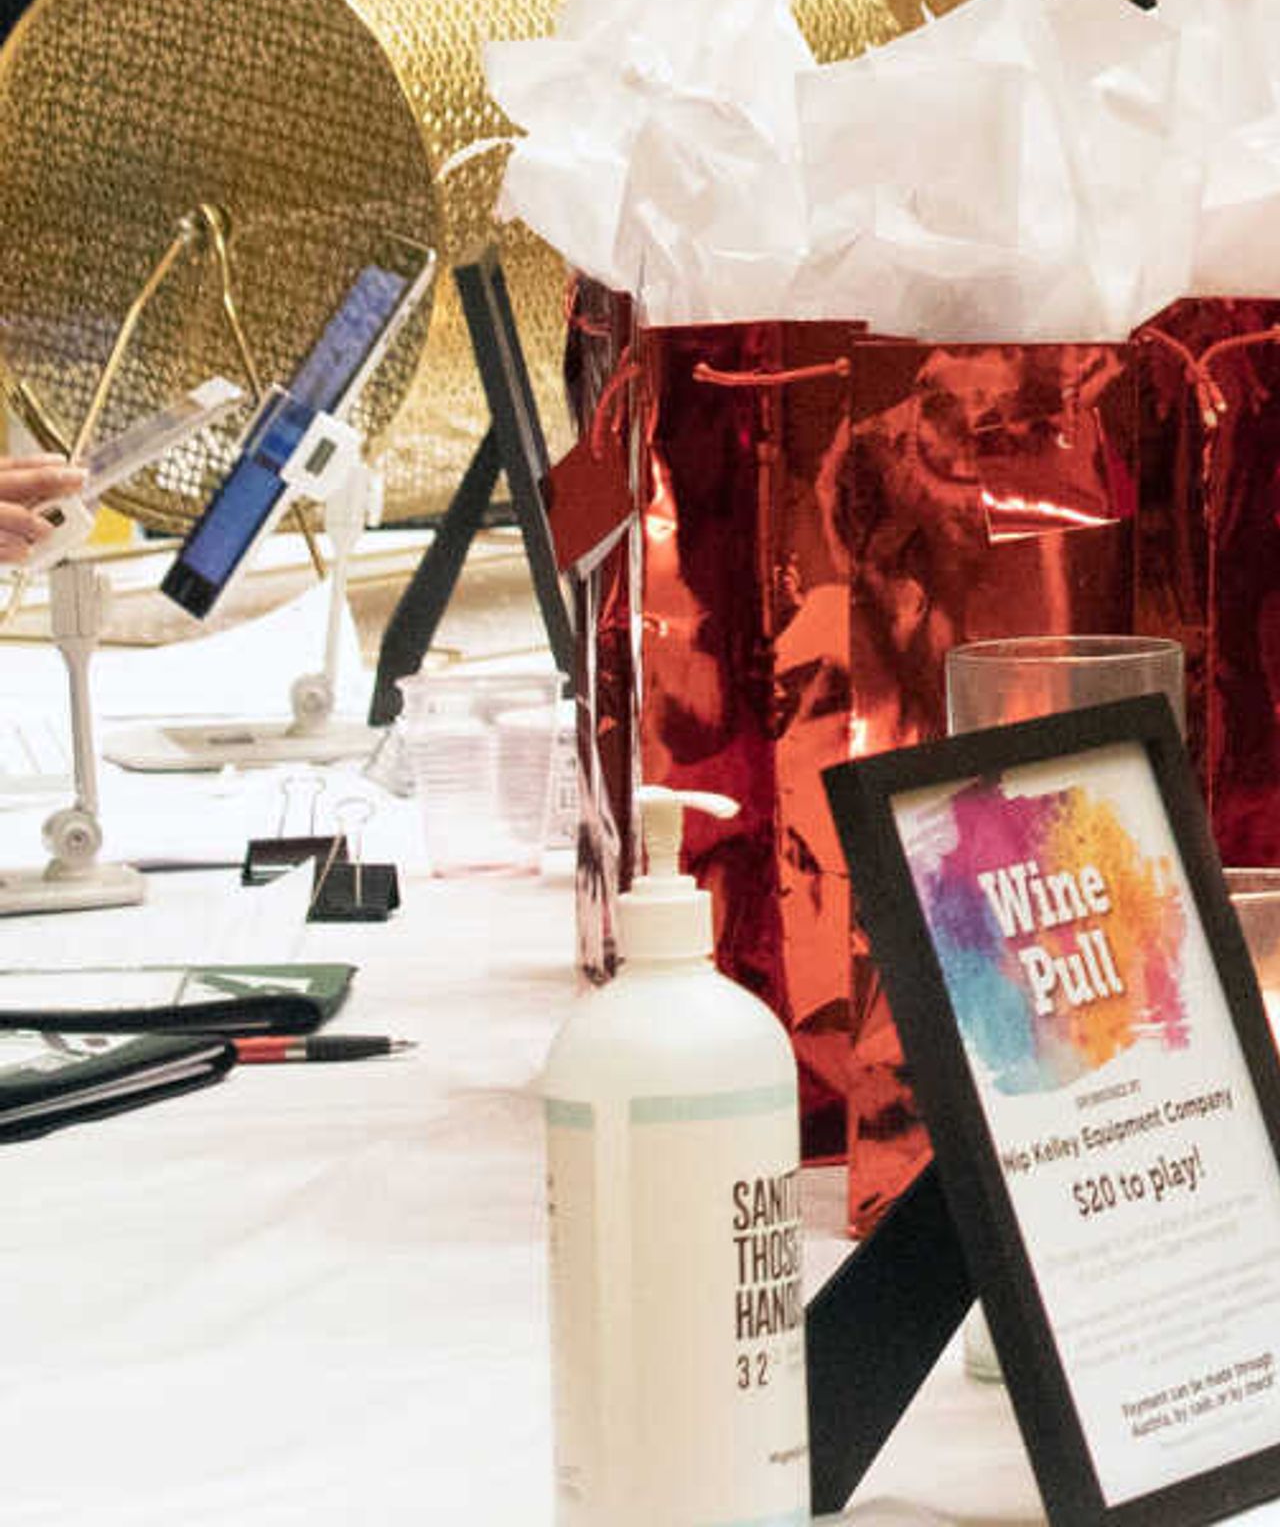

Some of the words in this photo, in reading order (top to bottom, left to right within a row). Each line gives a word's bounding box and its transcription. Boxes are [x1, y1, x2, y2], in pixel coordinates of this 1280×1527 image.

[977, 860, 1112, 938] Wine
[1018, 928, 1125, 1017] Pull
[1081, 1108, 1164, 1150] Equipment
[1163, 1088, 1234, 1124] Company
[1073, 1173, 1117, 1217] $20
[1120, 1176, 1145, 1202] to
[1151, 1145, 1206, 1202] play!
